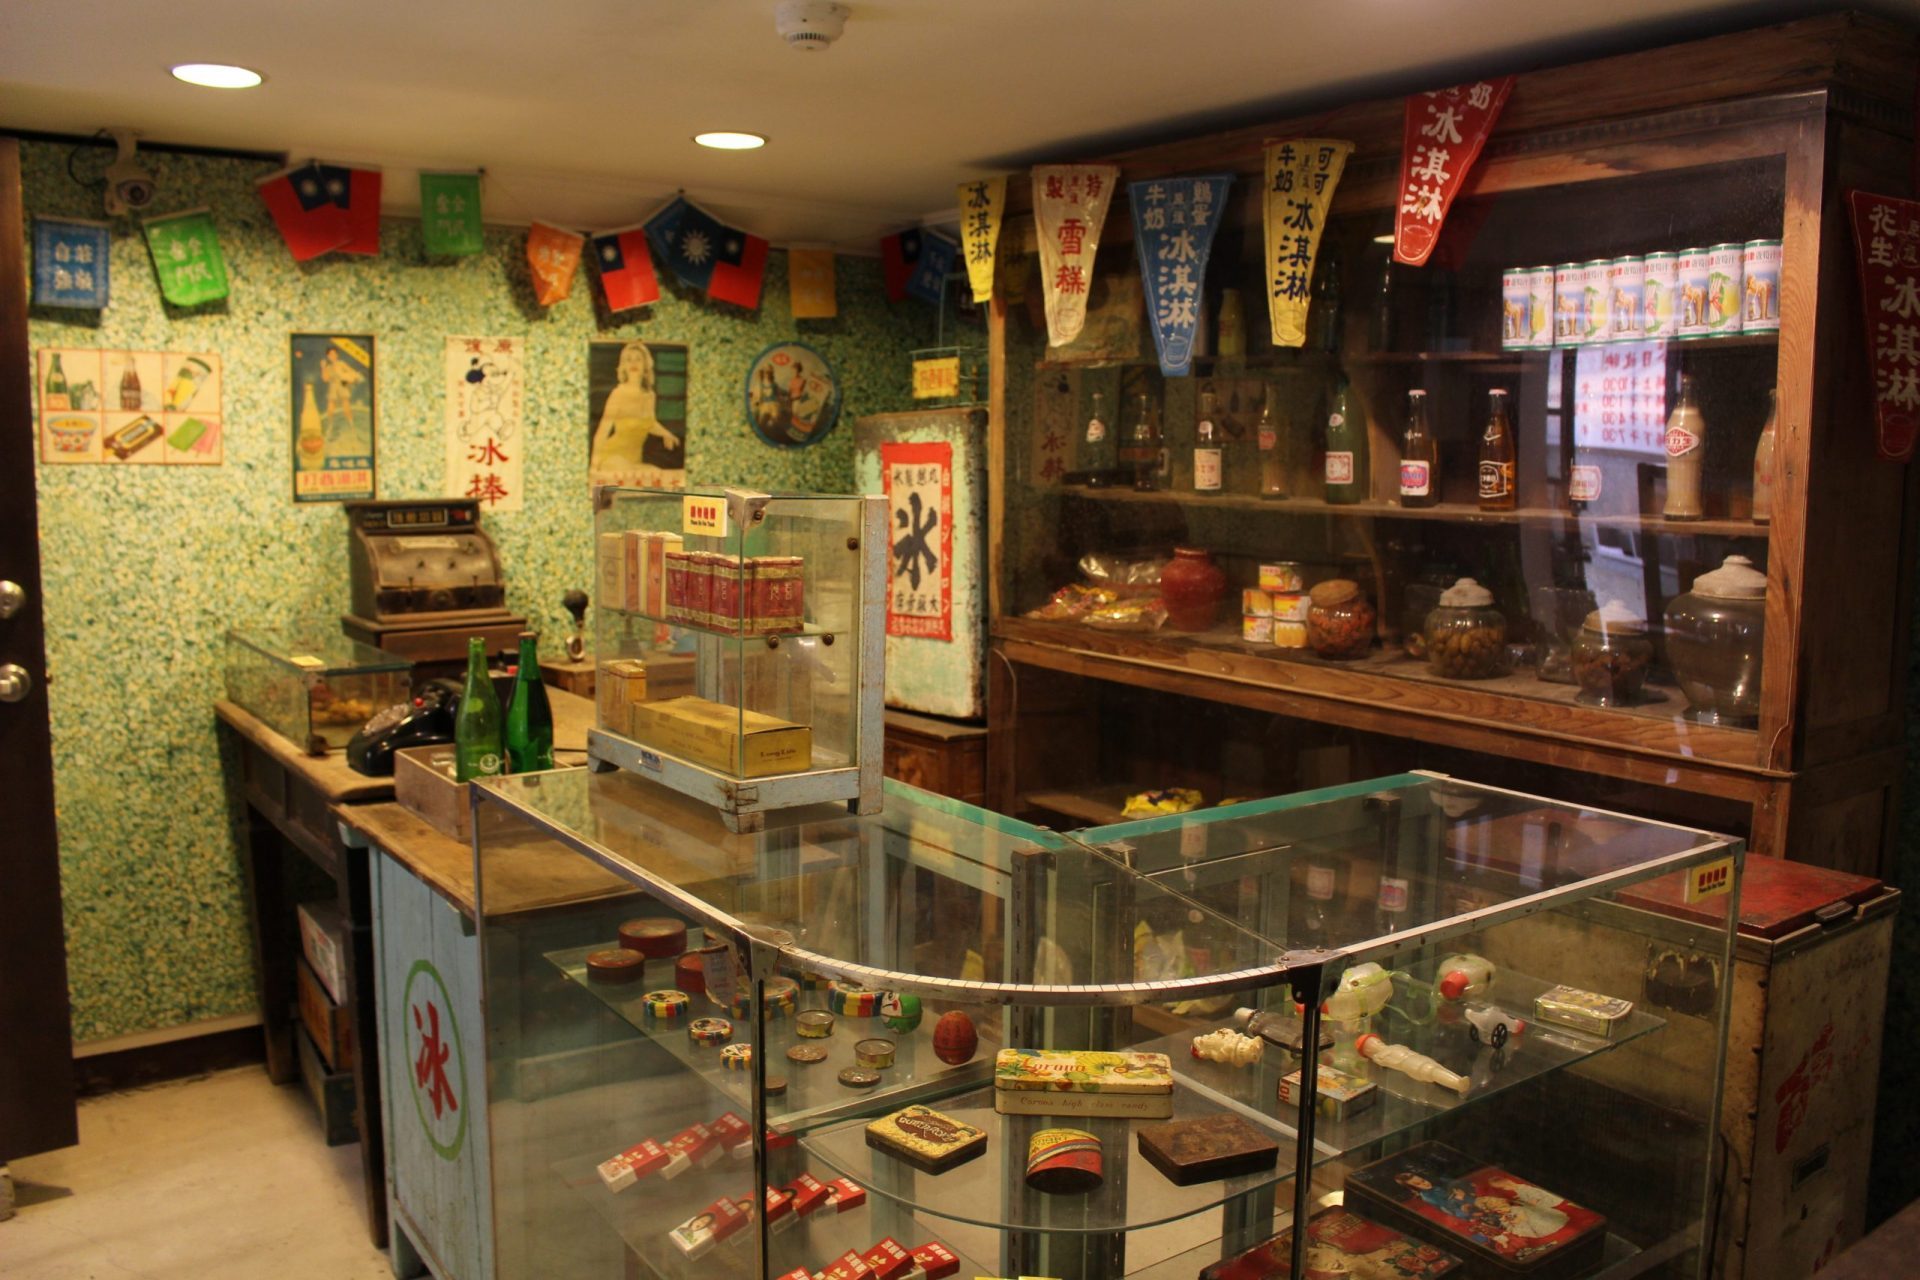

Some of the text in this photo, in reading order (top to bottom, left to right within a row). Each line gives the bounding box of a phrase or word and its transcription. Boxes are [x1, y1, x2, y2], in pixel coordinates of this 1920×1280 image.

[1272, 144, 1296, 192] 牛奶
[1313, 146, 1335, 196] 可可
[1401, 105, 1464, 225] 冰淇淋
[968, 181, 992, 265] 冰淇淋
[1143, 184, 1165, 230] 牛奶
[1867, 204, 1898, 268] 花生
[1158, 229, 1198, 329] 冰淇淋
[1274, 198, 1314, 303] 冰淇淋
[1876, 275, 1920, 411] 冰淇淋
[465, 437, 509, 507] 冰棒
